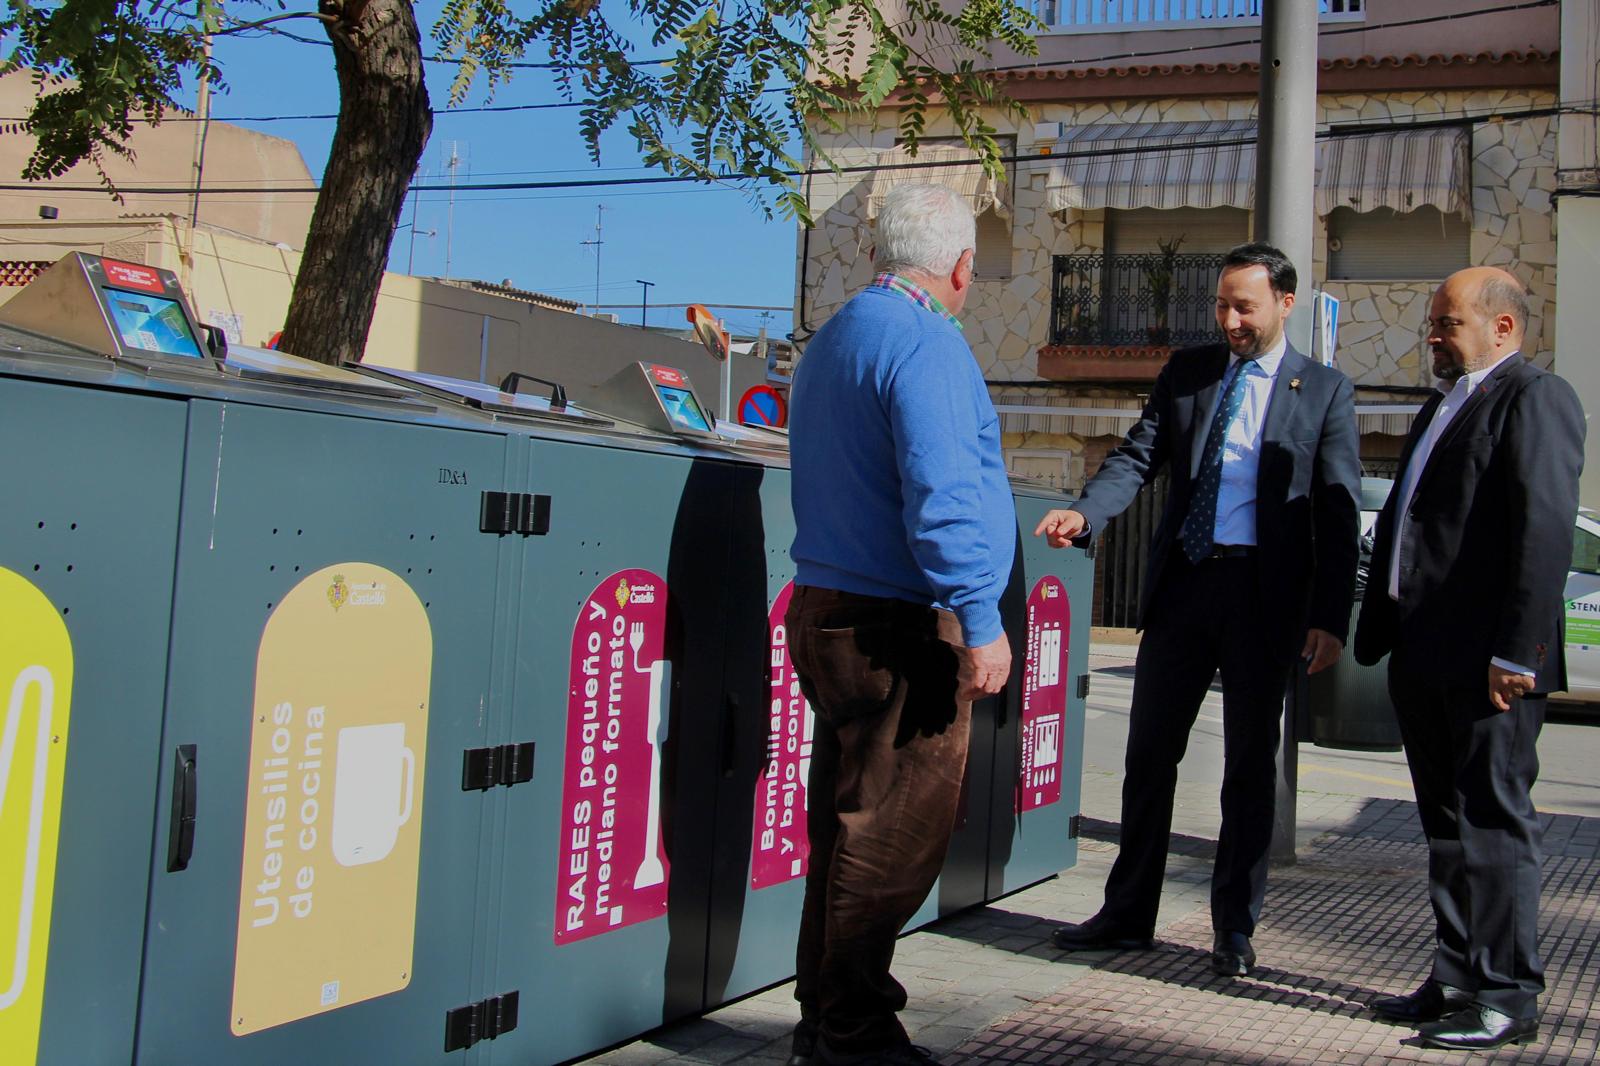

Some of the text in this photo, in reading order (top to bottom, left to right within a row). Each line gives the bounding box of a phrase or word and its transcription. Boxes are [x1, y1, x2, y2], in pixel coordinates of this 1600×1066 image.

[438, 468, 468, 485] ID&A
[1024, 676, 1032, 710] Pilas
[1026, 664, 1033, 673] y
[1570, 601, 1600, 613] STEN
[251, 701, 293, 929] Utensilios
[288, 705, 326, 919] de cocina
[566, 600, 607, 931] RAEES pequeño y
[595, 615, 626, 916] mediano formato
[760, 624, 787, 851] Bombillas LED
[780, 665, 800, 855] y bajo cons
[1026, 719, 1035, 788] cartuchos
